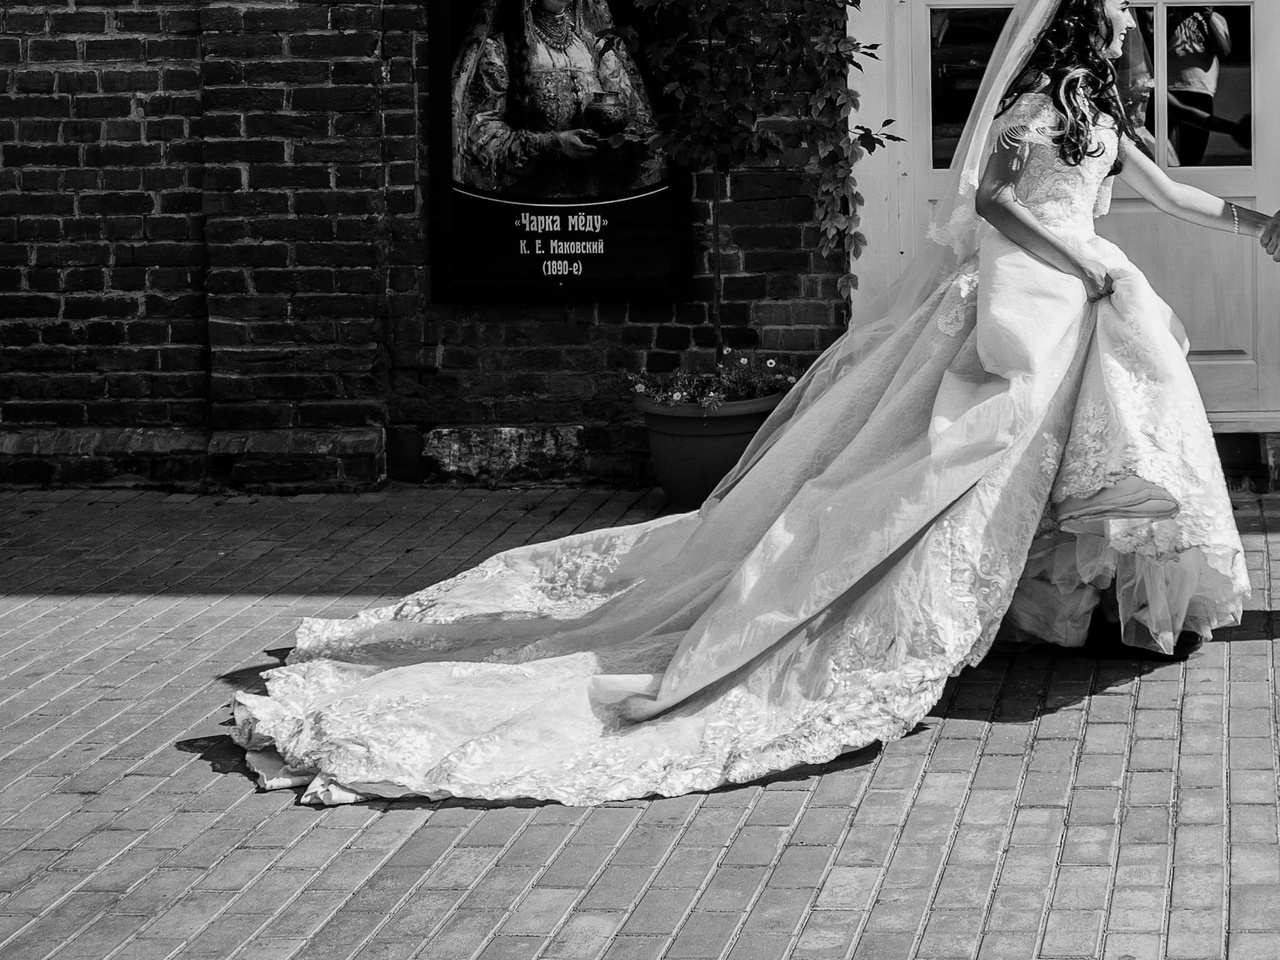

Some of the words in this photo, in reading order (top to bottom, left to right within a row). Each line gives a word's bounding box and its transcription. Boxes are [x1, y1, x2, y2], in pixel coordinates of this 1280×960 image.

[514, 212, 561, 233] «Чарка
[567, 212, 609, 233] мёду»
[519, 239, 531, 254] К.
[535, 239, 545, 254] Е.
[550, 238, 605, 254] Маковский
[542, 260, 583, 276] (1890-е)
